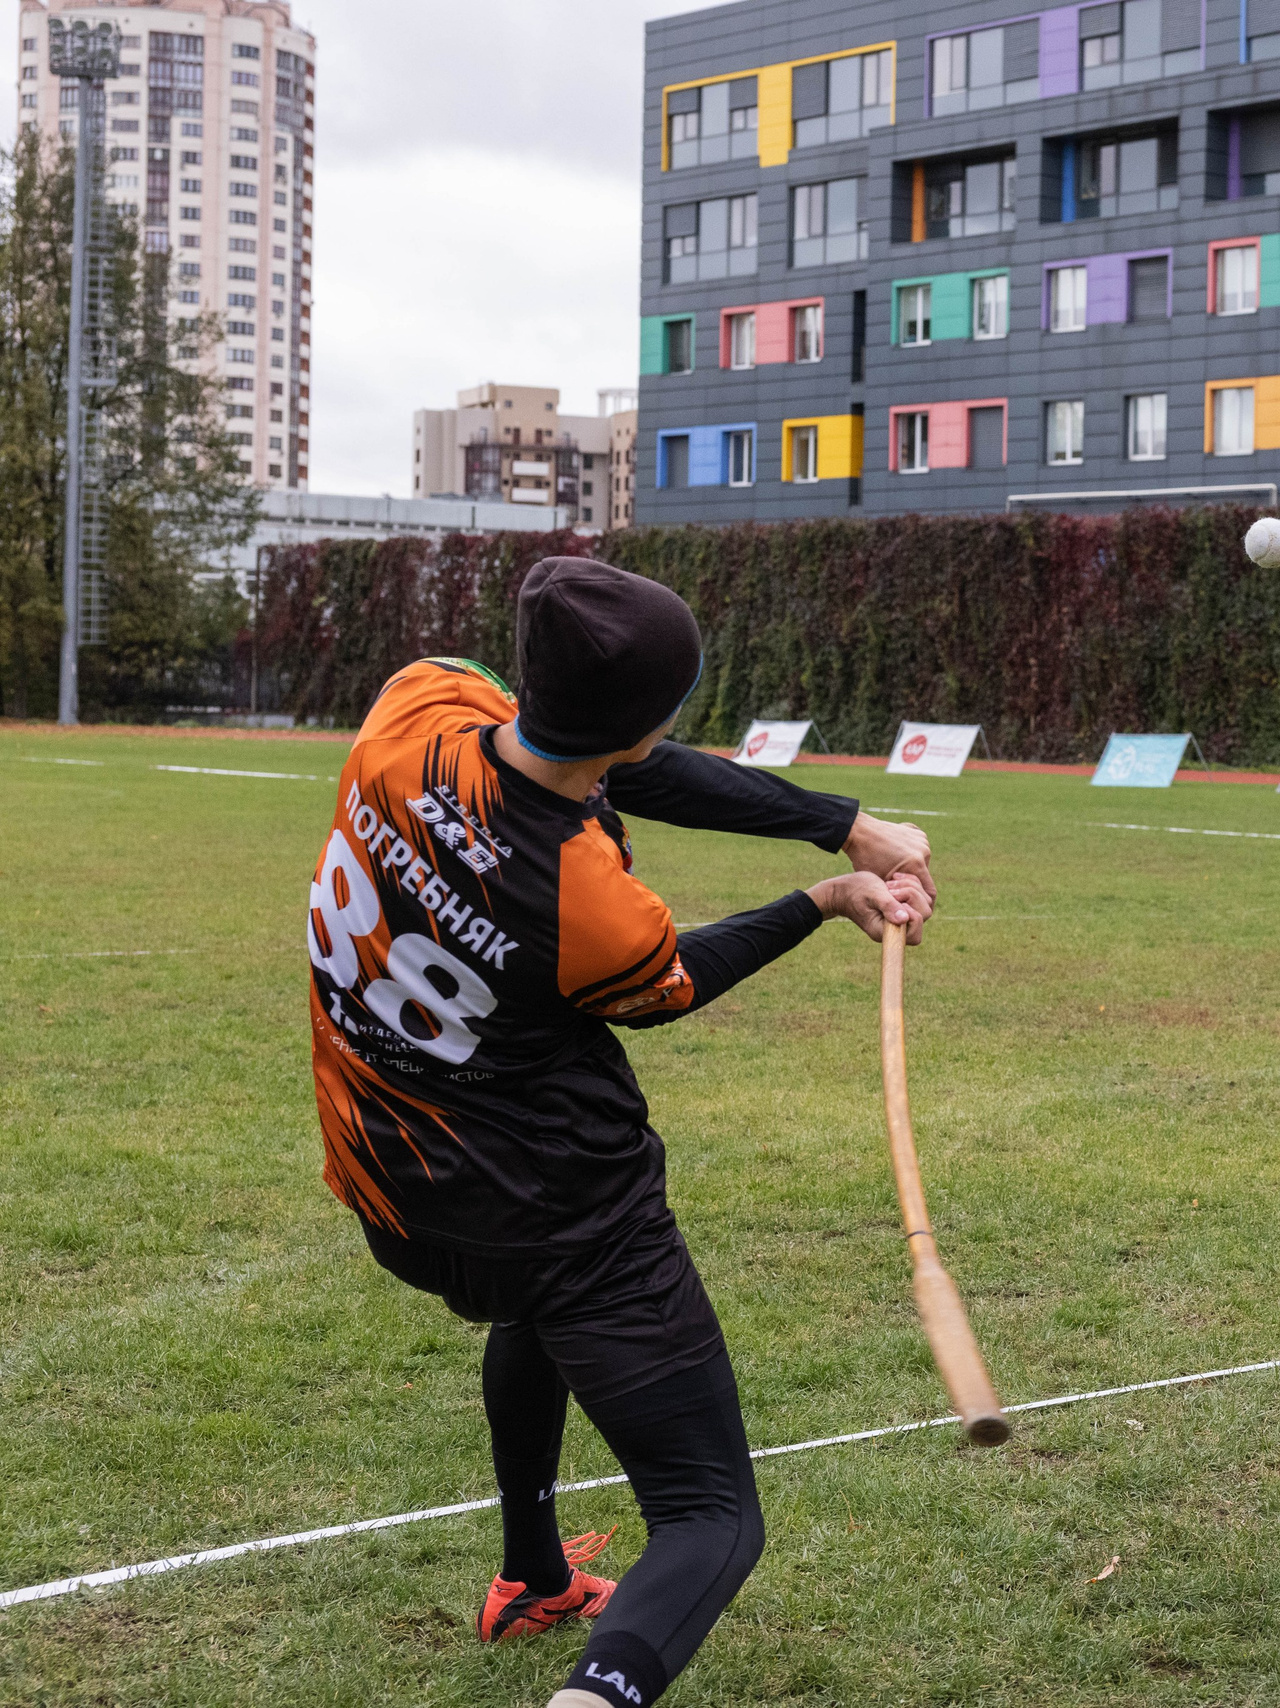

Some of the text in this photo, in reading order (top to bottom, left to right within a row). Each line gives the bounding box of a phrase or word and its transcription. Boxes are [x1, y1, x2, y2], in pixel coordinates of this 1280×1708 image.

[345, 779, 520, 971] ПОГРЕБНЯК
[438, 784, 513, 856] SIBERIA
[307, 828, 498, 1065] 88
[585, 1661, 643, 1706] LAP
